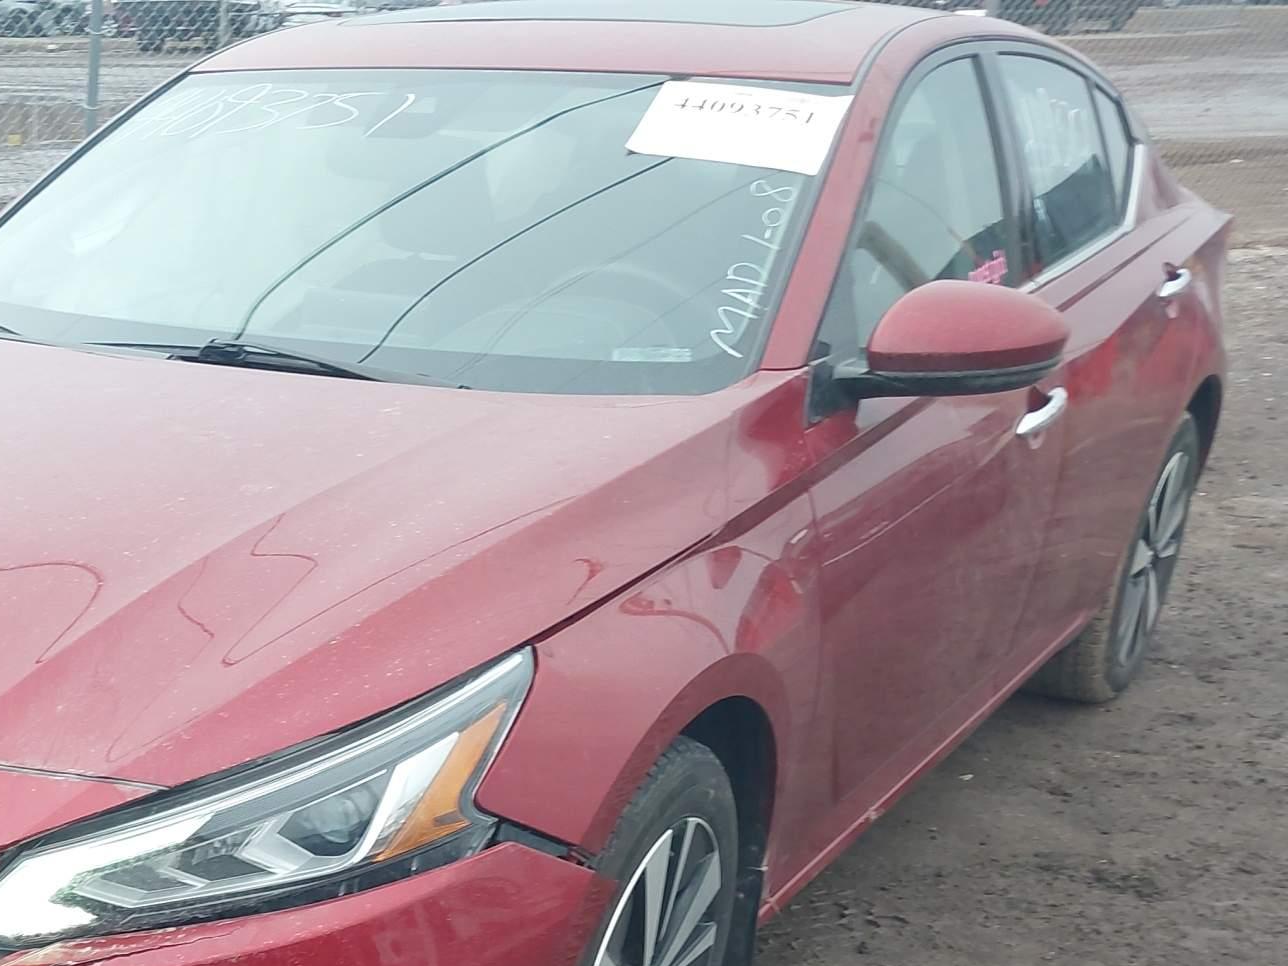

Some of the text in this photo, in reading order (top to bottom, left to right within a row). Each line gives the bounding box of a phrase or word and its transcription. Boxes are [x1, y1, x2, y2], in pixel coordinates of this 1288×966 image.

[672, 96, 815, 125] 44093751
[710, 179, 796, 358] MAD 1-08
